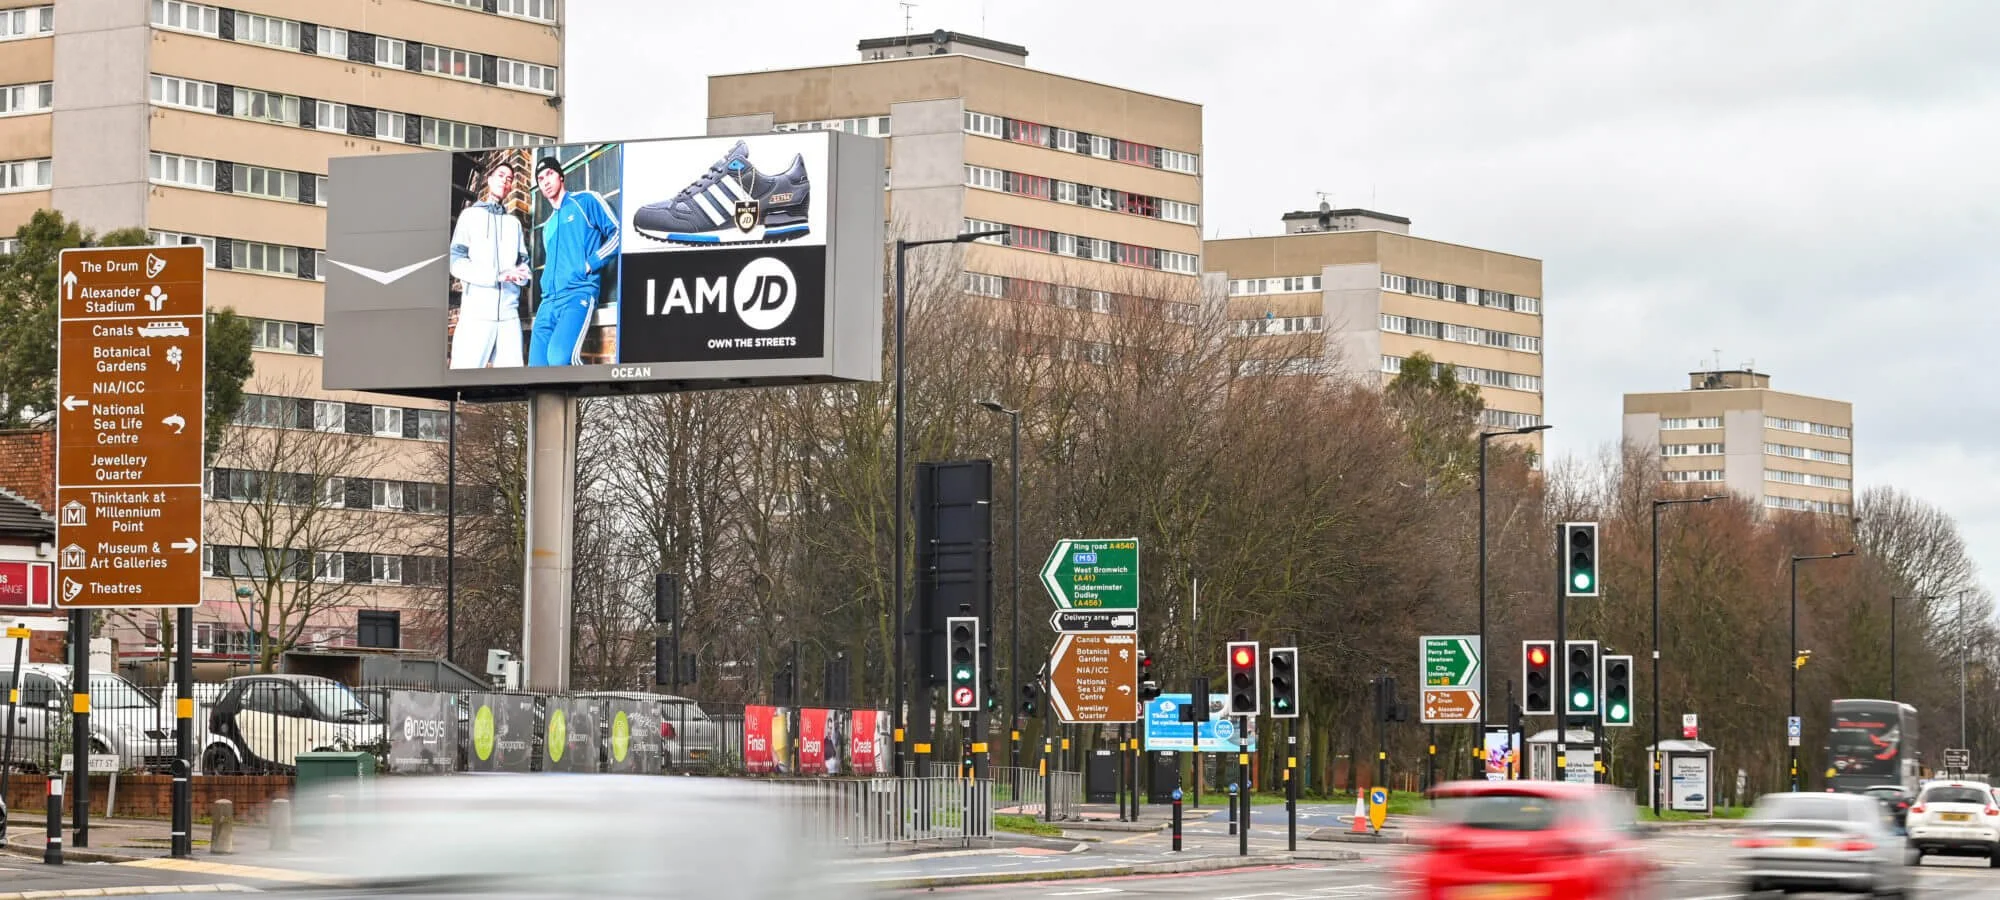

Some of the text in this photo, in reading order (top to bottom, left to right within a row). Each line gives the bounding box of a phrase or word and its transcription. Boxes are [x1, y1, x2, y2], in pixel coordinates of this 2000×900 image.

[81, 260, 138, 272] The Drum
[81, 287, 140, 298] Alexander
[646, 275, 788, 316] I AM JD
[86, 301, 135, 312] Stadium
[93, 324, 134, 336] Canals
[708, 337, 796, 349] OWN THE STREETS
[94, 346, 151, 358] Botanical
[97, 361, 147, 372] Gardens
[612, 367, 651, 378] OCEAN
[93, 381, 144, 394] NIA/ICC
[93, 404, 144, 415] National
[94, 418, 142, 430] Sea Life
[98, 433, 138, 444] Centre
[91, 454, 147, 467] Jewellery
[96, 469, 142, 480] Quarter
[90, 491, 165, 503] Thinktank at
[96, 507, 160, 518] Millennium
[113, 521, 144, 532] Point
[98, 542, 160, 554] Museum &
[90, 557, 167, 568] Art Galleries
[90, 582, 142, 593] Theatres
[747, 735, 766, 751] Finish
[802, 737, 821, 757] Design
[854, 738, 872, 753] Create
